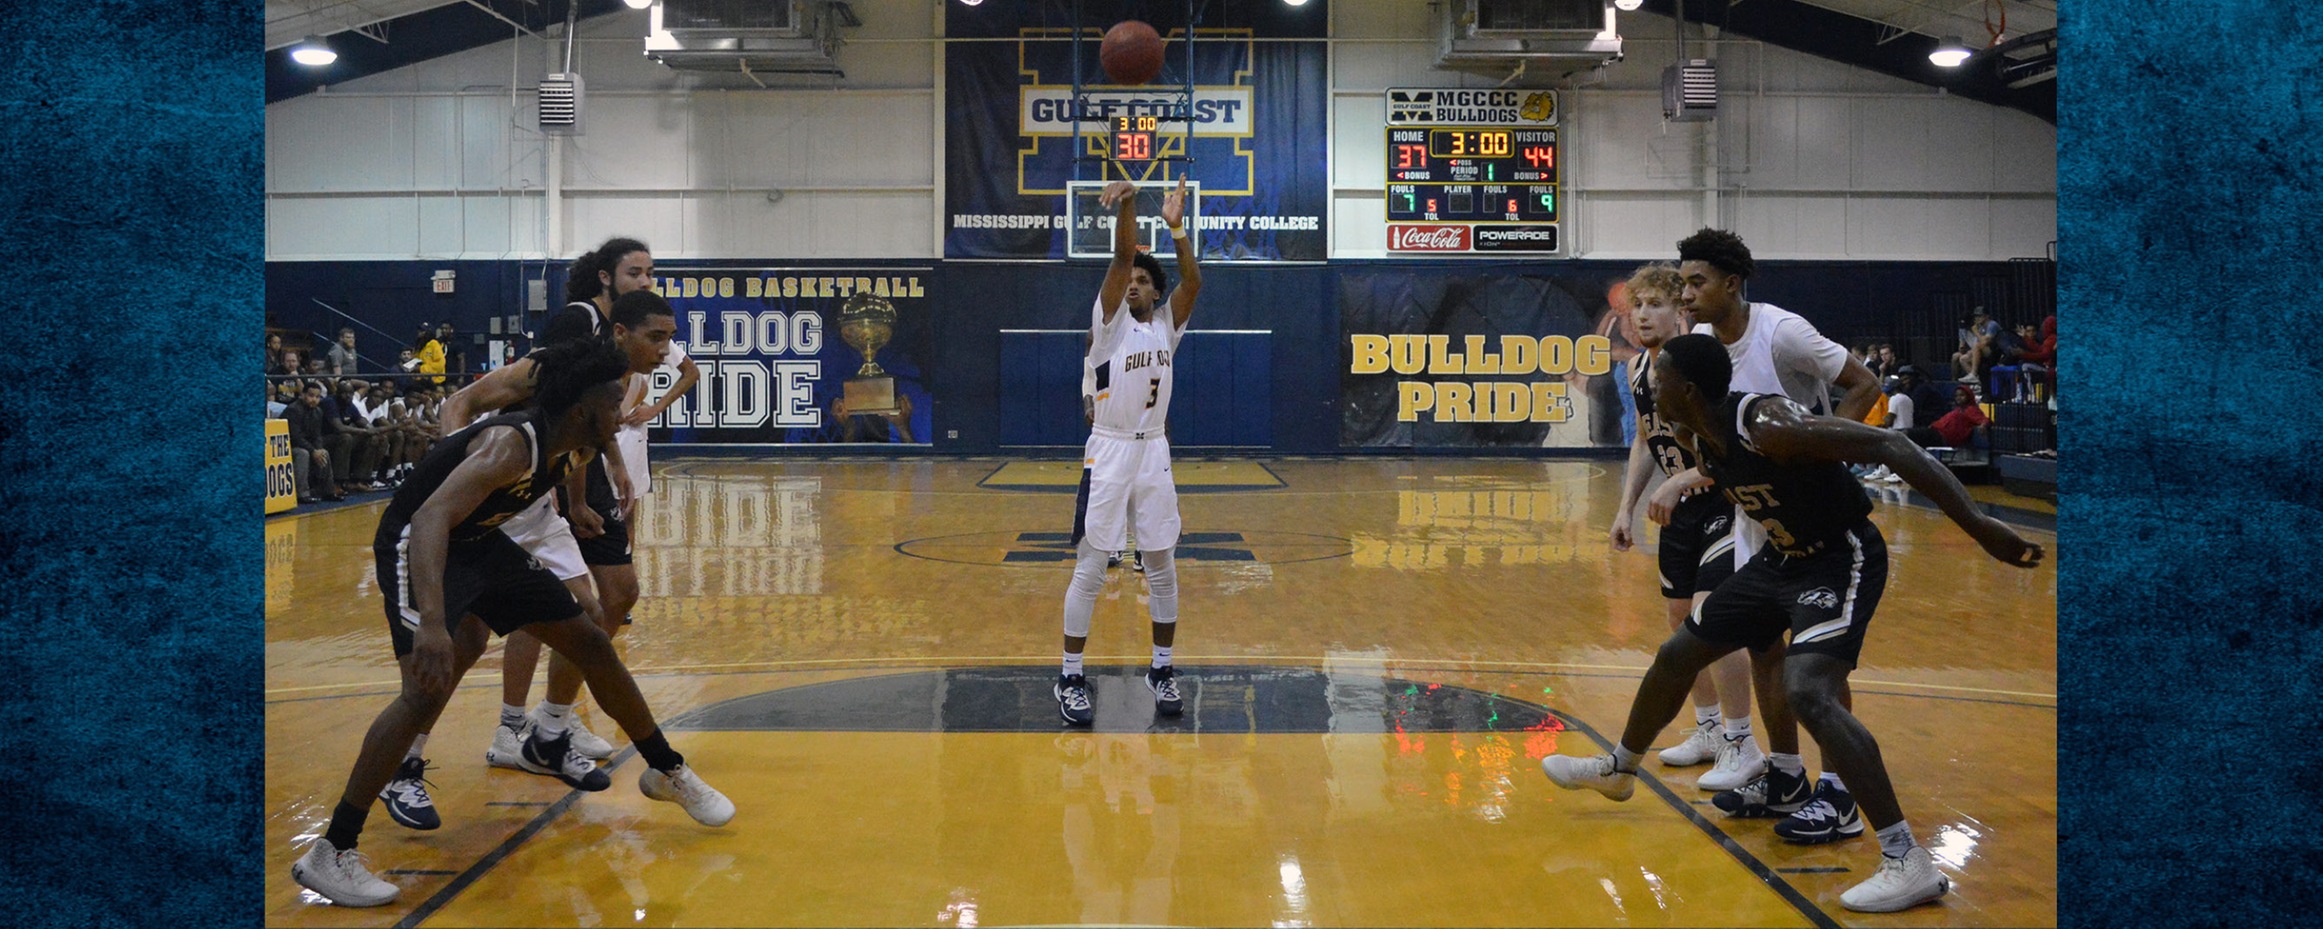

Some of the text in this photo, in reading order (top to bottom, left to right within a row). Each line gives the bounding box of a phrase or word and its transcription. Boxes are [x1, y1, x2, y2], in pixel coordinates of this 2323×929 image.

[1437, 91, 1518, 107] MGCCC
[1437, 108, 1518, 122] BULLDOGS
[1120, 117, 1156, 131] 3:00
[1393, 131, 1424, 142] HOME
[1451, 132, 1508, 155] 3:00
[1516, 131, 1556, 142] VISITOR
[1118, 134, 1149, 159] 30
[1398, 145, 1427, 168] 37
[1524, 146, 1553, 168] 44
[1404, 171, 1431, 180] BONUS
[1450, 166, 1478, 175] PERIOD
[1487, 163, 1494, 181] 1
[1514, 172, 1539, 180] BONUS
[1391, 185, 1415, 194] FOULS
[1444, 185, 1473, 194] PLAYER
[1483, 185, 1508, 194] FOULS
[1529, 185, 1553, 194] FOULS
[1403, 194, 1415, 212] 7
[1427, 199, 1437, 212] 5
[1507, 199, 1518, 213] 6
[1541, 194, 1553, 213] 9
[953, 214, 1049, 229] MISSISSIPPI
[1097, 215, 1150, 229] COT
[1154, 216, 1246, 230] COUNITY
[1250, 216, 1319, 230] COLLEGE
[1424, 213, 1439, 221] TOL
[1505, 213, 1520, 221] TOL
[1402, 227, 1465, 249] Coca-Cola
[1479, 231, 1550, 240] POWERADE
[436, 281, 451, 291] EXIT
[746, 277, 924, 298] BASKETBALL
[675, 310, 822, 355] LDOG
[1350, 334, 1611, 375] BULLDOG
[1145, 377, 1161, 409] 3
[1397, 381, 1567, 422] PRIDE
[270, 434, 290, 457] THE
[265, 462, 293, 498] OGS
